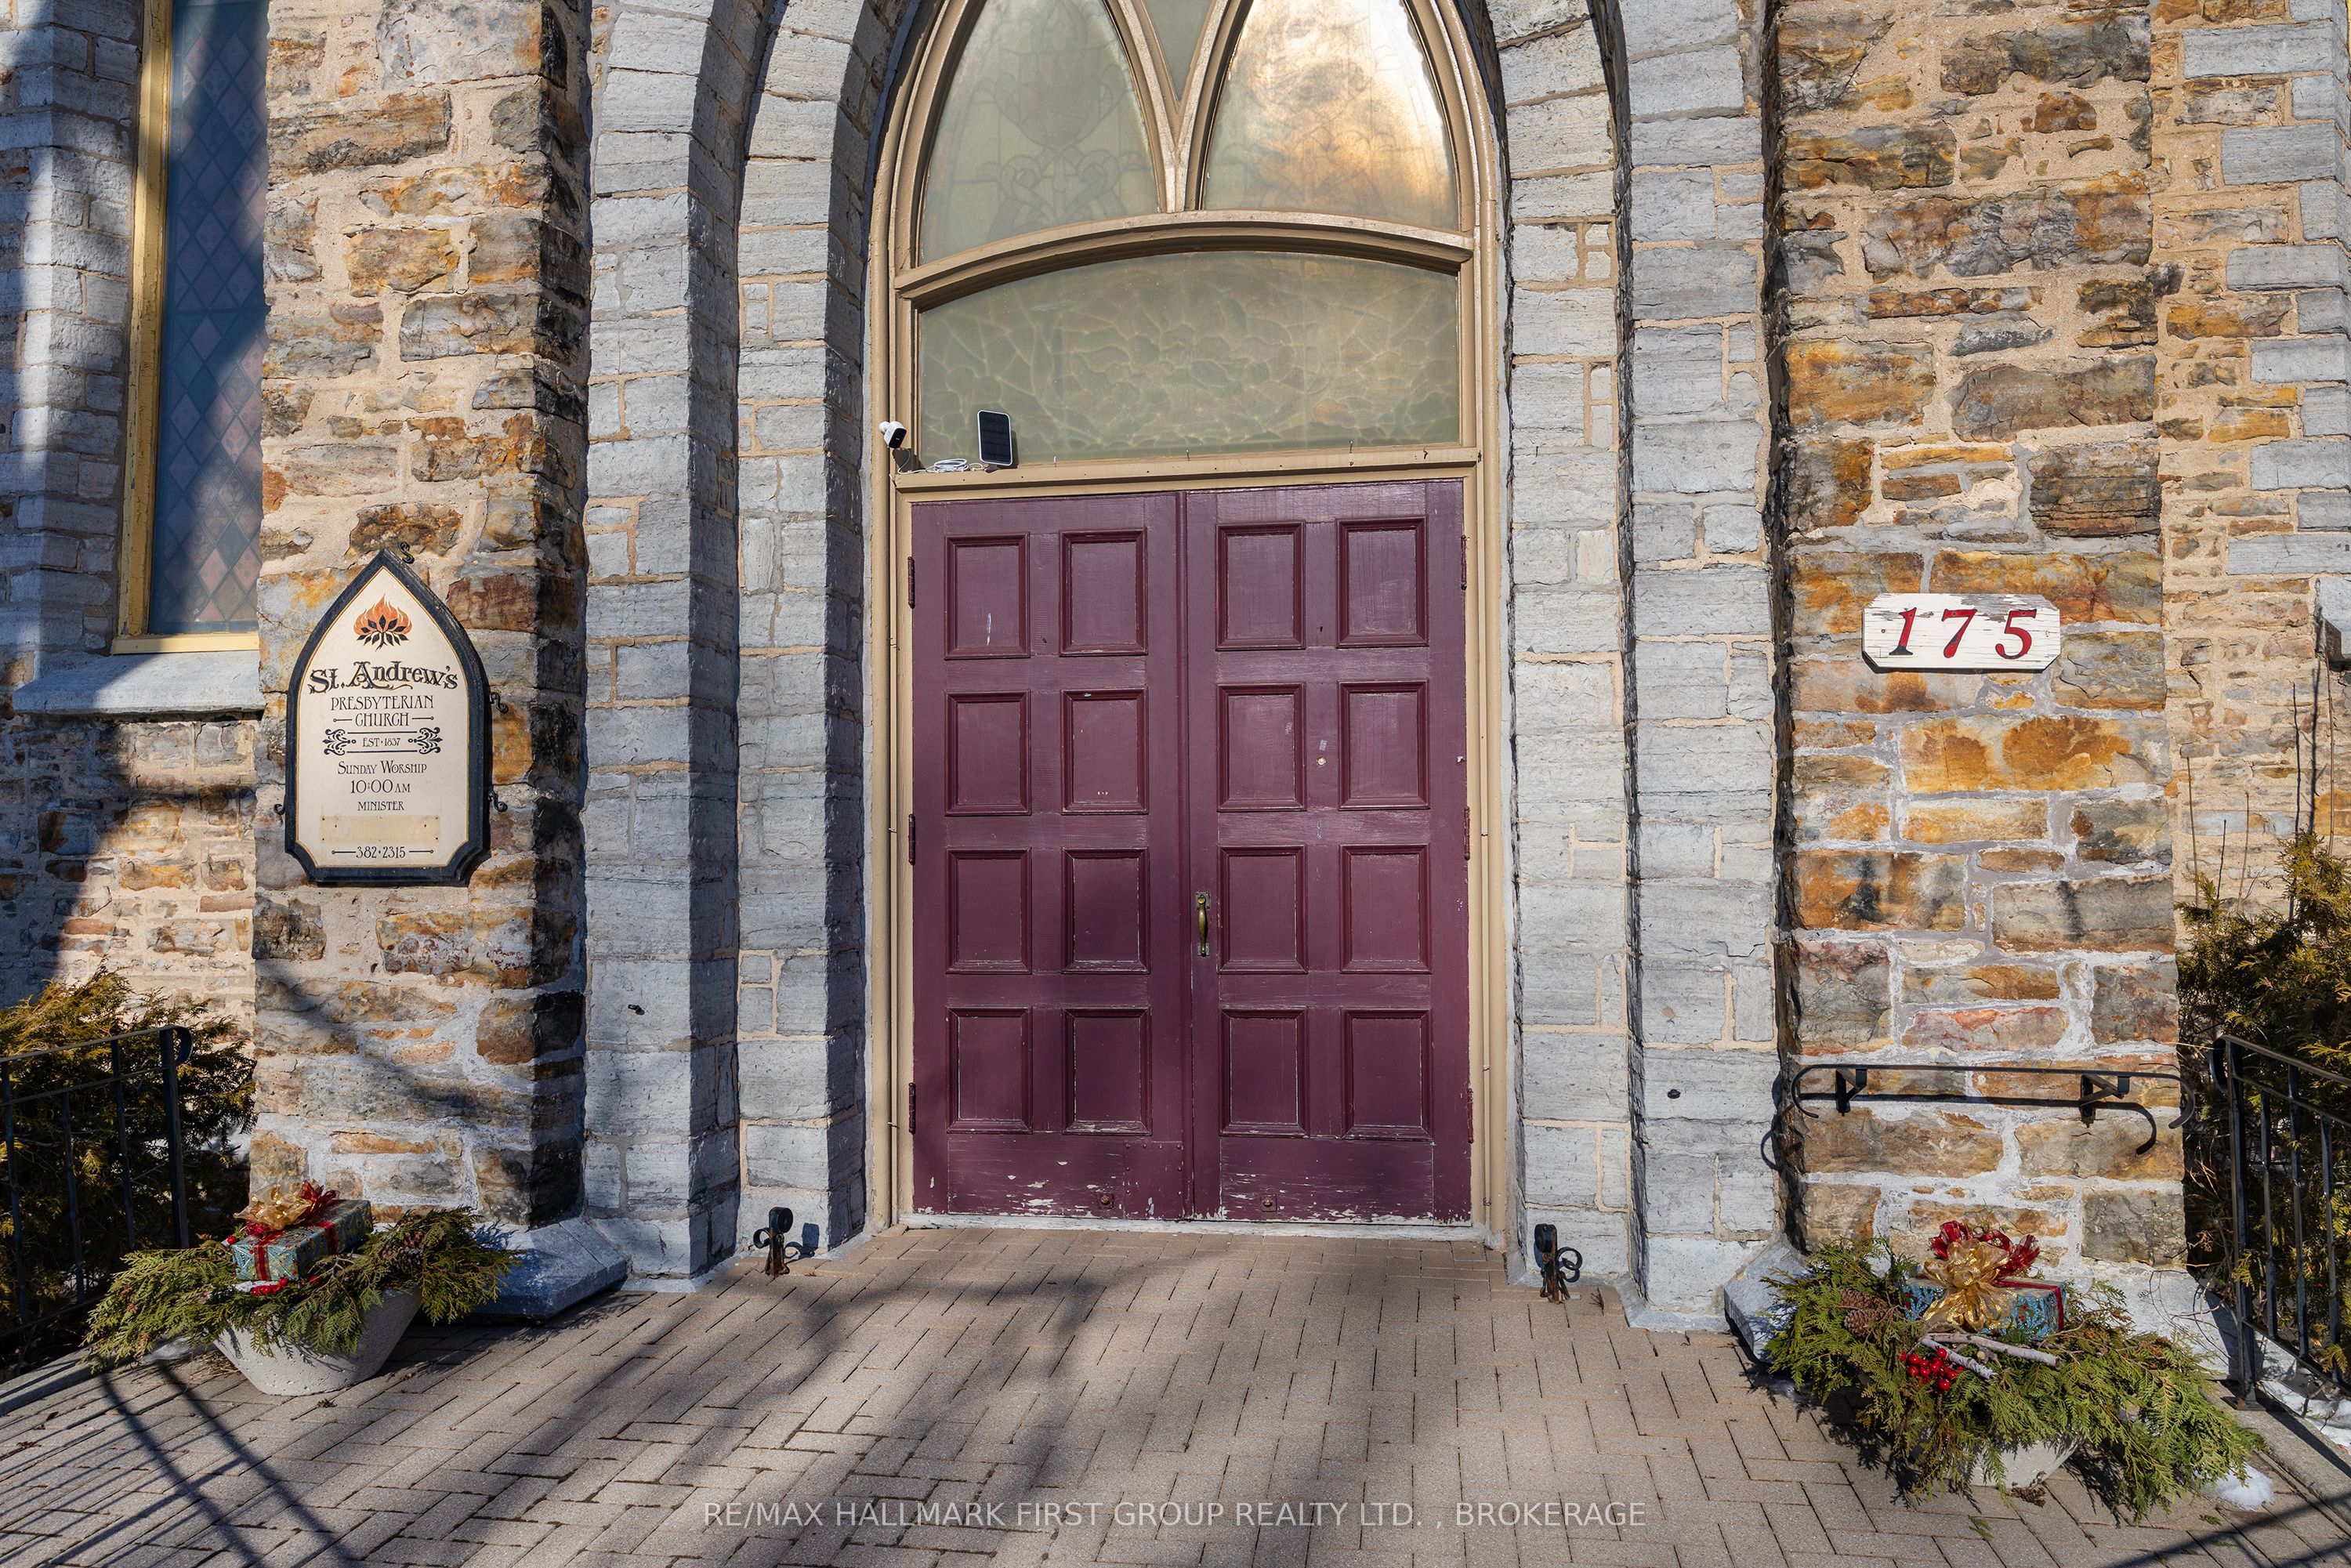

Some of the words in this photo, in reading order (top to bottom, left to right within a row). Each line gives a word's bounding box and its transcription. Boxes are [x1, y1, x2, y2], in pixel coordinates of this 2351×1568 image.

[1888, 607, 2038, 660] 175
[307, 668, 345, 694] St.
[346, 660, 458, 690] Andrew's
[331, 695, 434, 711] PRESBYTERIAN
[355, 712, 409, 727] CHURCH
[350, 779, 393, 794] 10:00
[394, 783, 411, 793] AM
[357, 801, 404, 811] MINISTER
